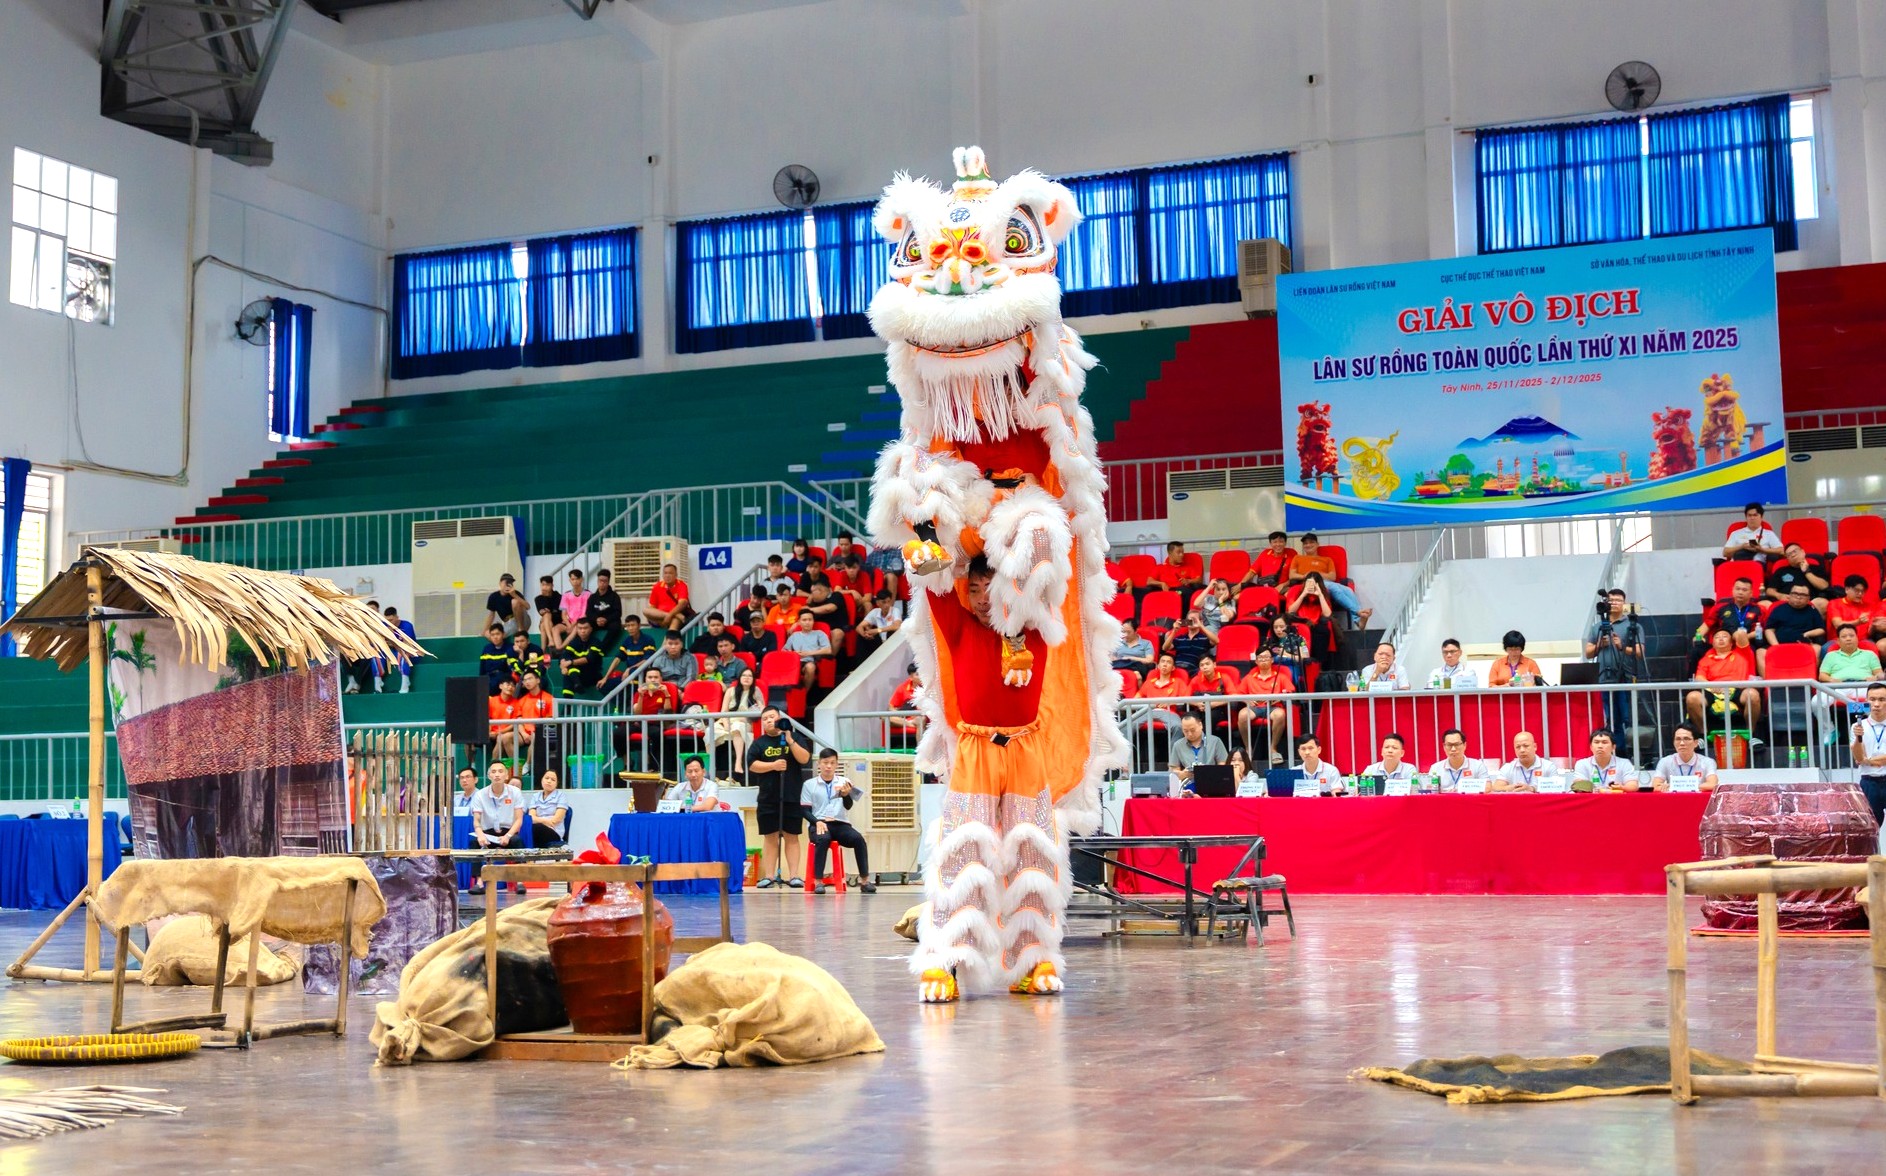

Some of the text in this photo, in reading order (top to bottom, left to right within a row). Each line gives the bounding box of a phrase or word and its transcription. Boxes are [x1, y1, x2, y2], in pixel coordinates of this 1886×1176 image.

[1601, 259, 1614, 268] VĂN
[1633, 253, 1646, 265] THỂ
[1648, 254, 1665, 264] THAO
[1667, 252, 1675, 262] VÀ
[1677, 252, 1686, 261] DU
[1688, 251, 1703, 261] LỊCH
[1723, 247, 1736, 256] TÂY
[1738, 246, 1754, 255] NINH
[1440, 266, 1545, 284] CỤC THỂ DỤC THỂ THAO VIỆT NAM
[1326, 284, 1338, 294] LÂN
[1349, 281, 1365, 292] RỒNG
[1366, 280, 1380, 291] VIỆT
[1382, 280, 1396, 288] NAM
[1398, 290, 1639, 333] GIẢI VÔ ĐỊCH
[1314, 328, 1738, 380] LÂN SƯ RỒNG TOÀN QUỐC LẦN THỨ XI NĂM 2025
[1442, 385, 1458, 394] Tây
[1460, 383, 1483, 392] Ninh,
[1486, 378, 1542, 390] 25/11/2025
[1550, 373, 1602, 385] 2/12/2025
[704, 550, 727, 566] A4
